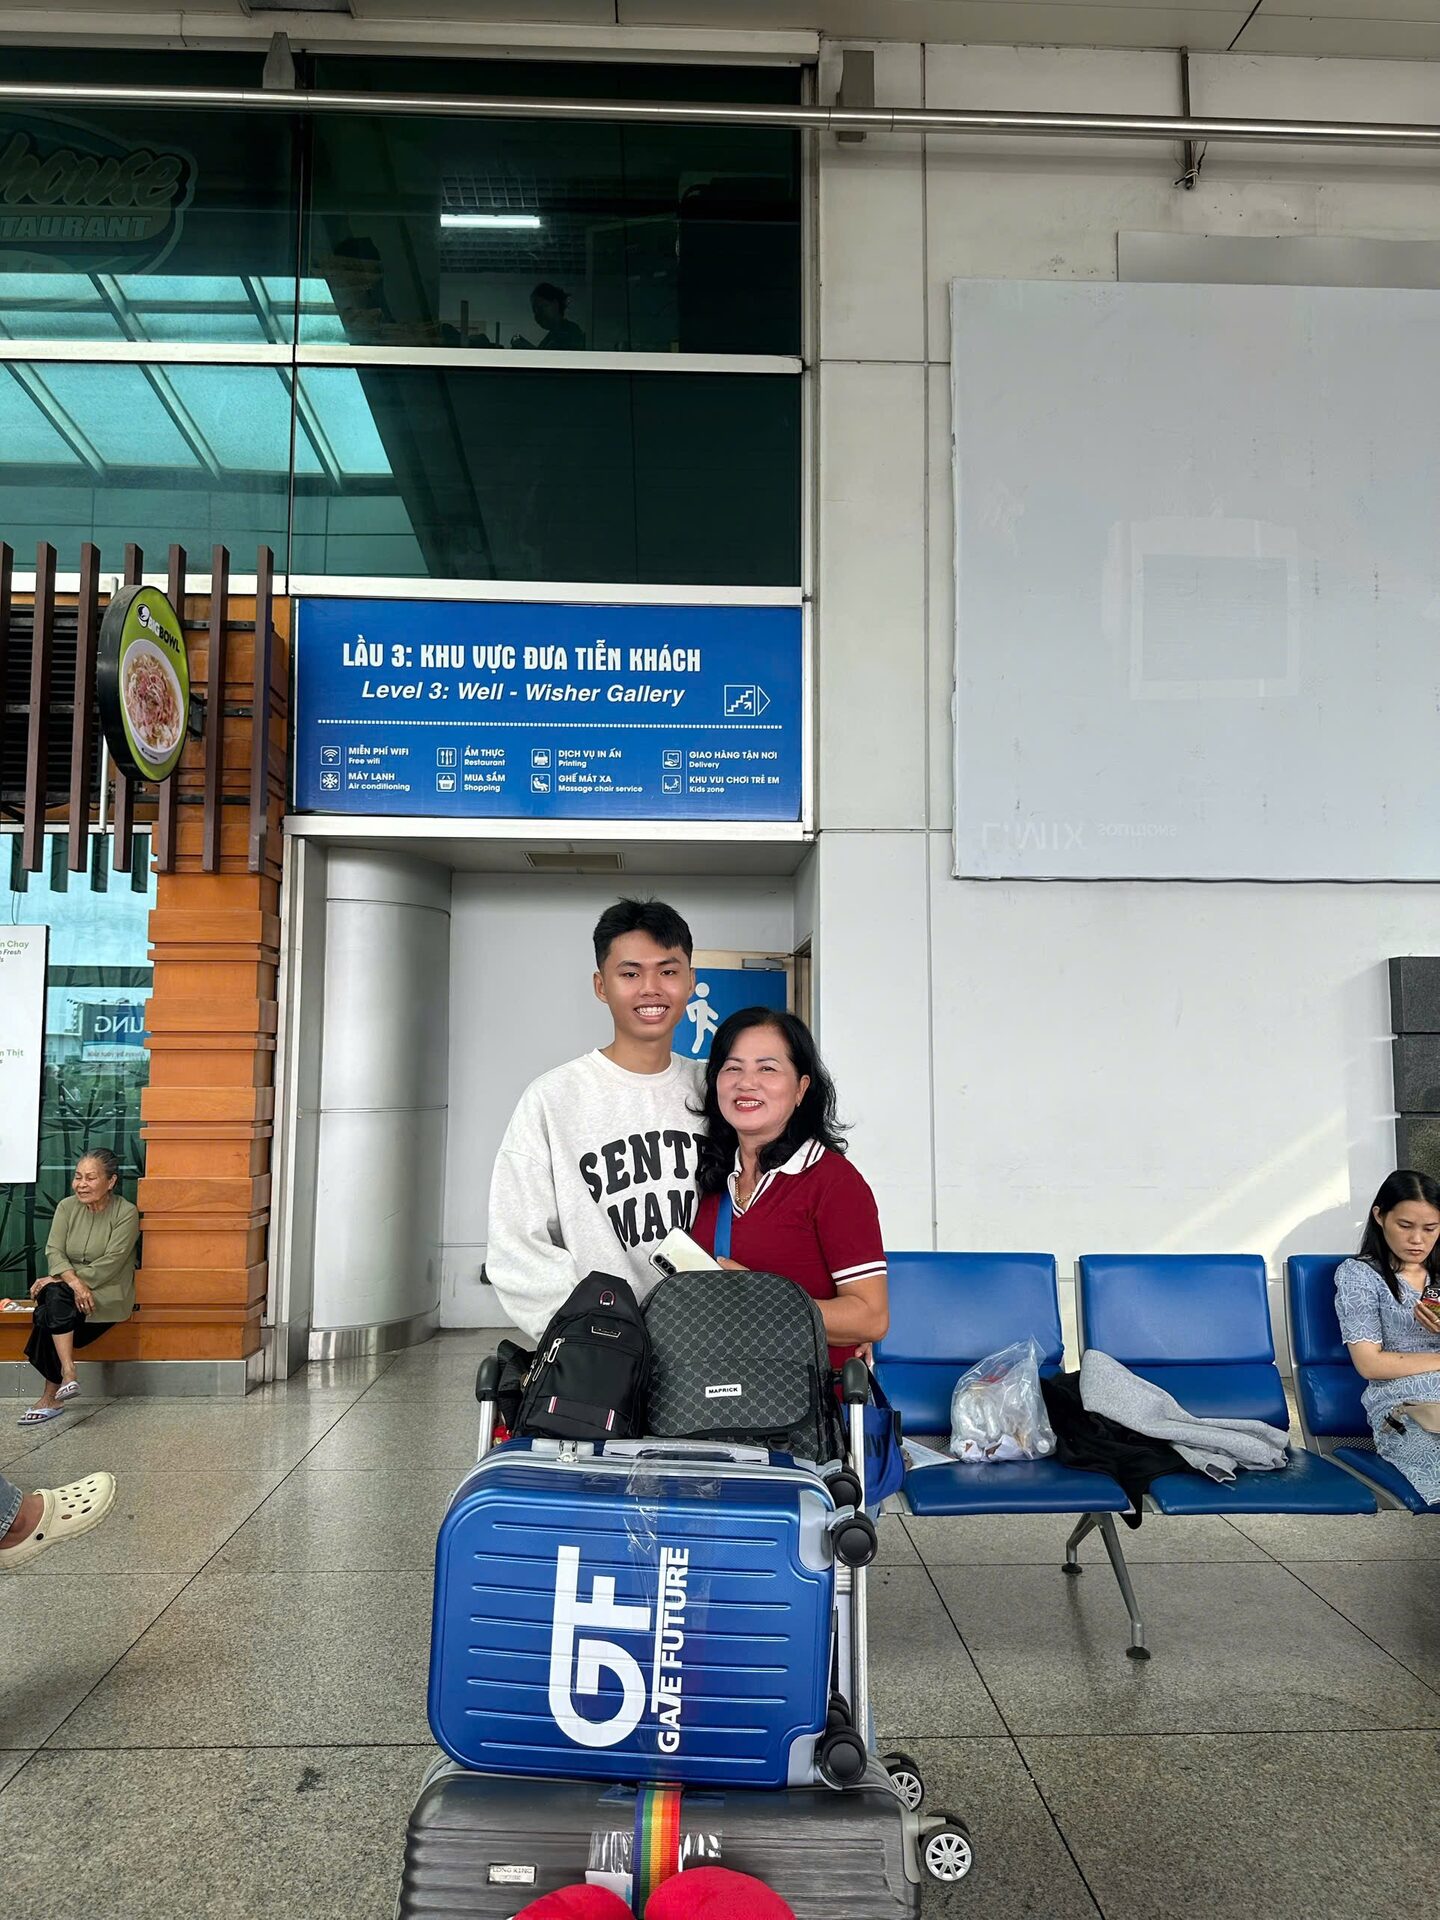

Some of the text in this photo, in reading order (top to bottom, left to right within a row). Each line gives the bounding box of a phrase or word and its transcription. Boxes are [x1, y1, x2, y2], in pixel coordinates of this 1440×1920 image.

[343, 634, 701, 674] LẦU 3: KHU VỰC ĐƯA TIỄN KHÁCH
[362, 681, 423, 699] Level
[428, 682, 450, 700] 3:
[458, 682, 504, 700] Well
[526, 683, 601, 702] Wisher
[607, 684, 685, 707] Gallery
[348, 744, 409, 756] MIỄN PHÍ WIFI
[481, 748, 505, 759] THỰC
[558, 750, 581, 760] DỊCH
[583, 750, 595, 760] VỤ
[609, 748, 622, 758] ẤN
[688, 749, 778, 761] GIAO HÀNG TẬN NƠI
[558, 760, 587, 769] Printing
[688, 761, 720, 769] Delivery
[348, 771, 395, 783] MÁY LẠNH
[464, 774, 484, 782] MUA
[558, 772, 612, 783] GHẾ MÁT XA
[689, 776, 708, 784] KHU
[709, 776, 724, 784] VUI
[726, 775, 749, 784] CHƠI
[751, 774, 766, 784] TRẺ
[361, 783, 411, 792] conditioning
[464, 784, 501, 793] Shopping
[558, 785, 593, 793] Massage
[7, 940, 30, 950] Chay
[6, 1048, 24, 1059] Thịt
[579, 1129, 706, 1204] SENT
[663, 1547, 690, 1669] FUTURE
